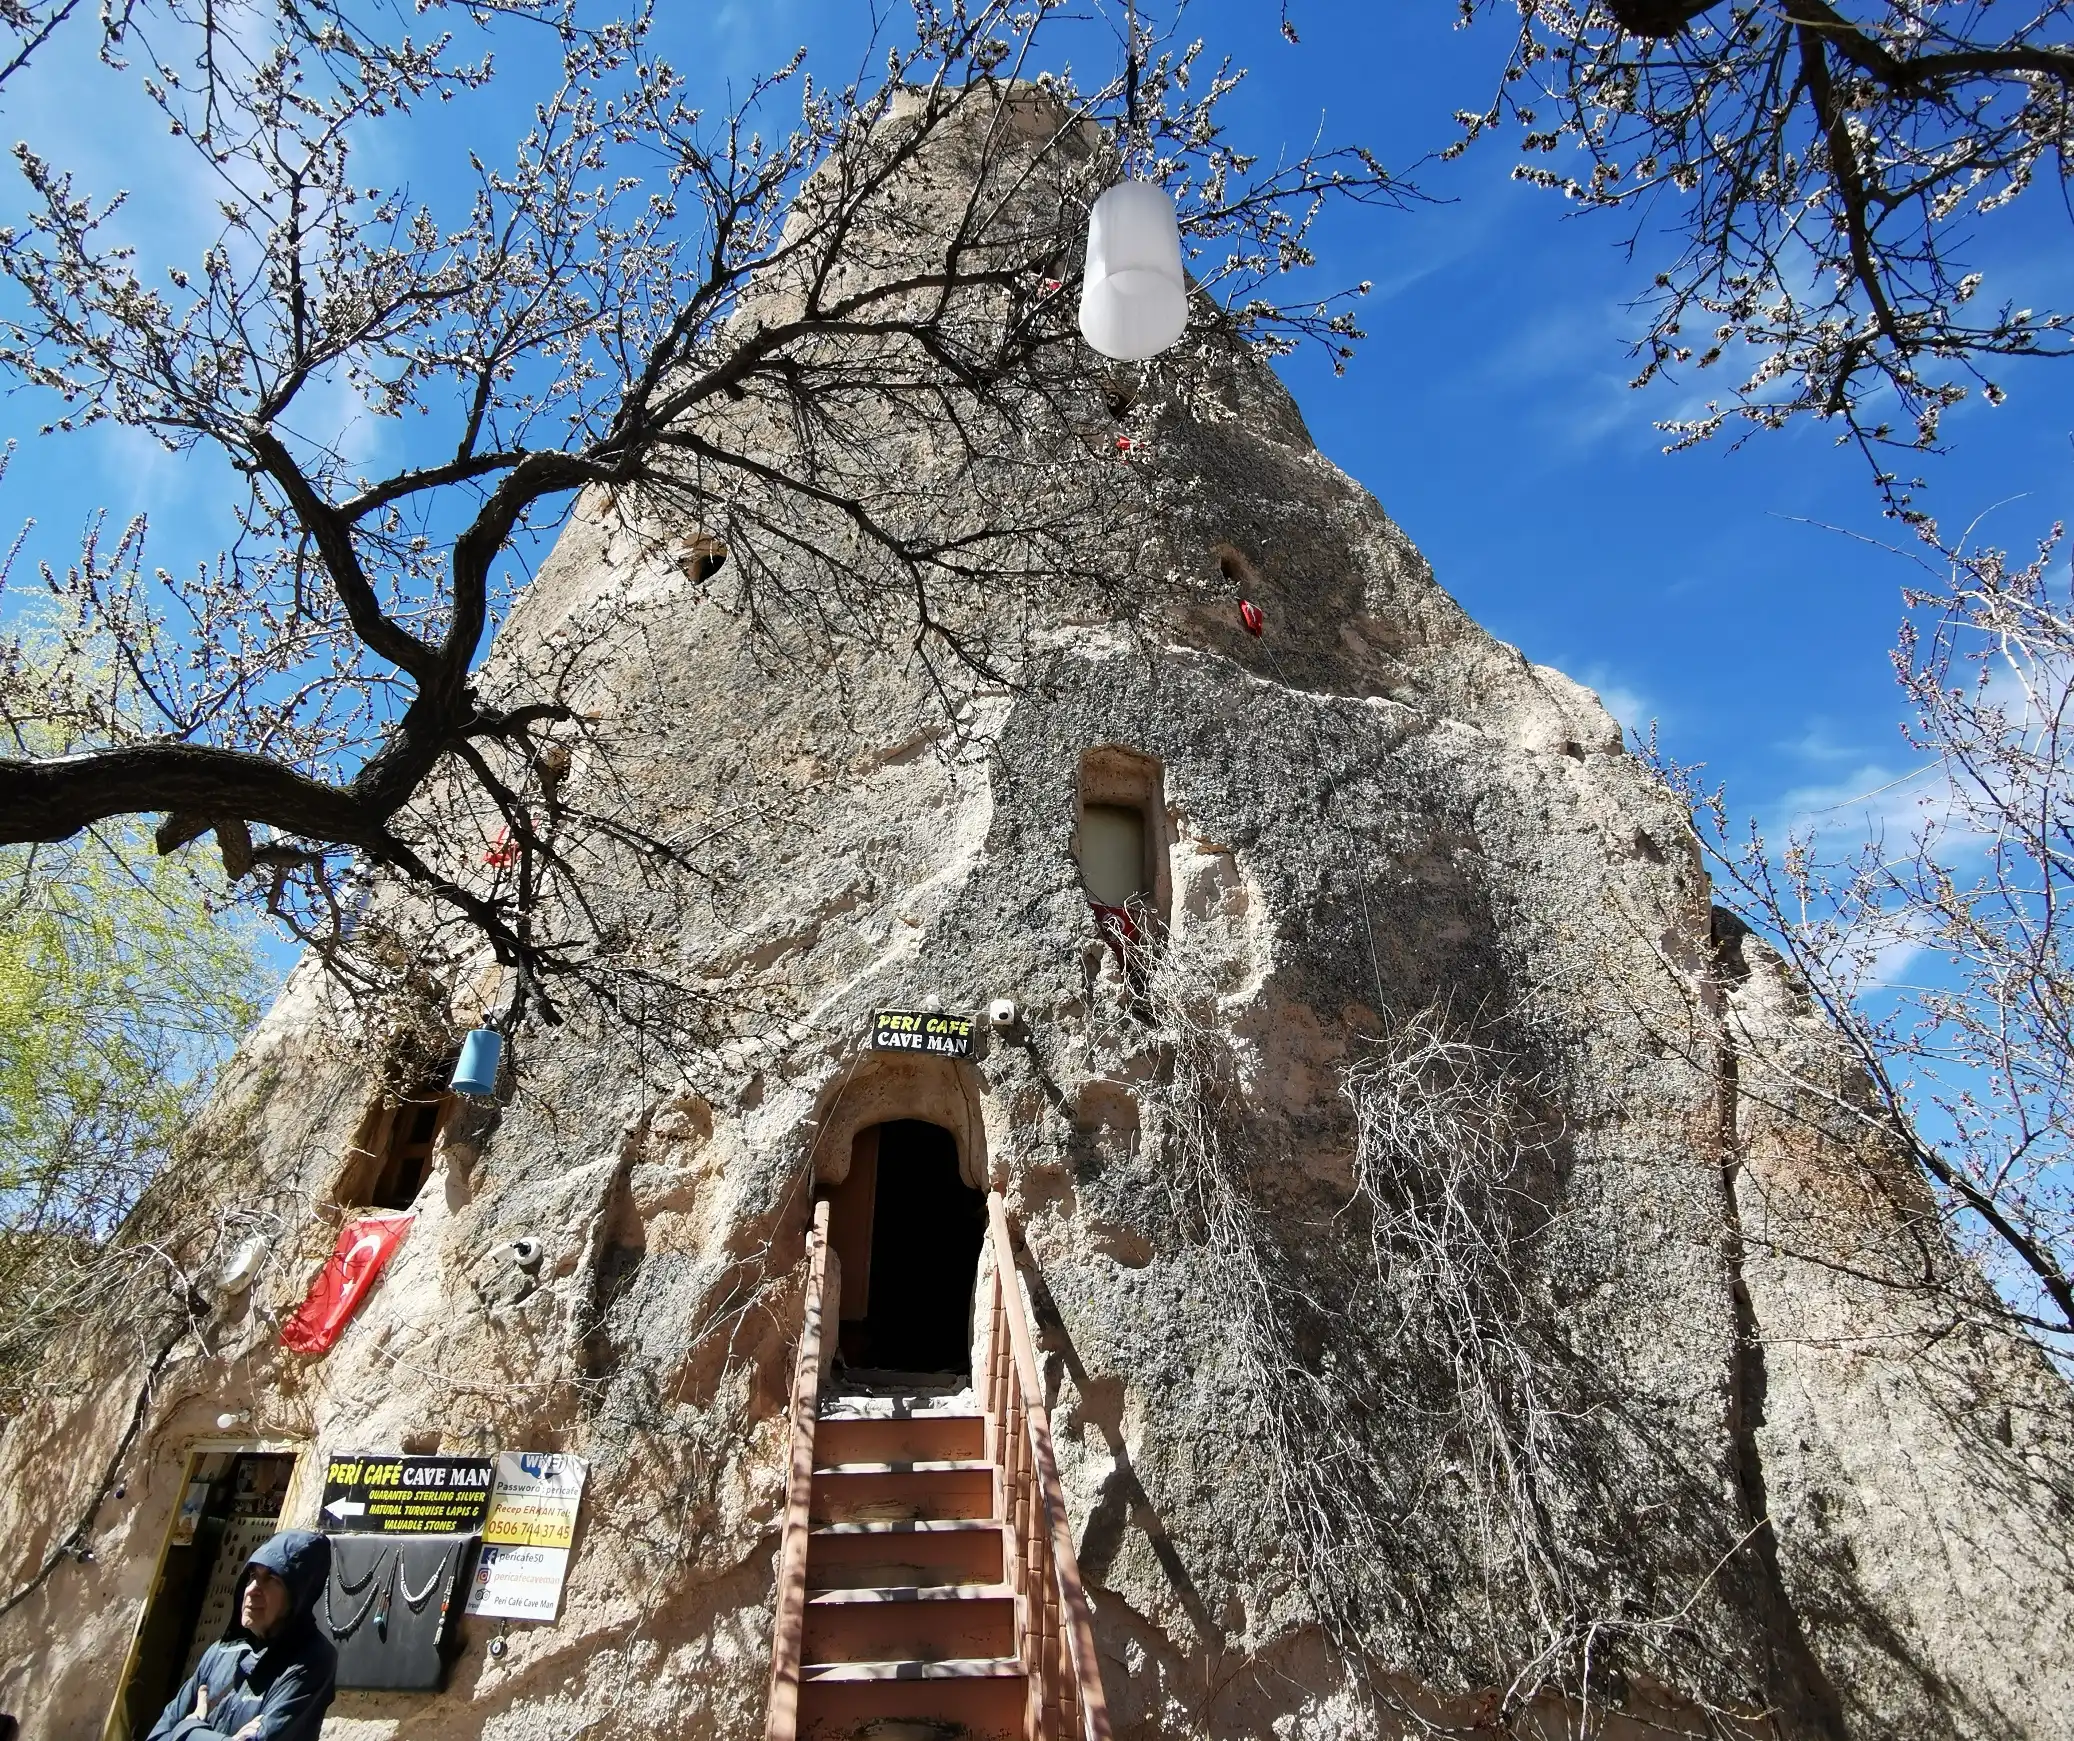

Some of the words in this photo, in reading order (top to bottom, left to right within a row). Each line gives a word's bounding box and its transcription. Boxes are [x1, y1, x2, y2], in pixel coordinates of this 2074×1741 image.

[877, 1032, 922, 1048] CAVE
[926, 1034, 968, 1053] MAN
[363, 1460, 403, 1485] CAFÉ
[403, 1467, 446, 1486] CAVE
[450, 1468, 492, 1486] MAN
[414, 1490, 454, 1502] STERLING
[456, 1491, 486, 1502] SILVER
[368, 1504, 402, 1515] NATURAL
[403, 1505, 445, 1516] TURQUISE
[446, 1505, 471, 1516] LAPIS
[471, 1506, 479, 1516] &
[495, 1503, 522, 1516] Recep
[523, 1505, 555, 1517] ERKAN
[384, 1519, 422, 1530] VALUABLE
[423, 1520, 457, 1531] STONES
[488, 1520, 518, 1535] 0506
[520, 1522, 540, 1537] 744
[541, 1524, 556, 1538] 37
[557, 1525, 570, 1540] 45
[499, 1552, 544, 1564] pericafe50
[494, 1596, 506, 1605] Peri
[523, 1598, 538, 1608] Cave
[540, 1600, 554, 1609] Man
